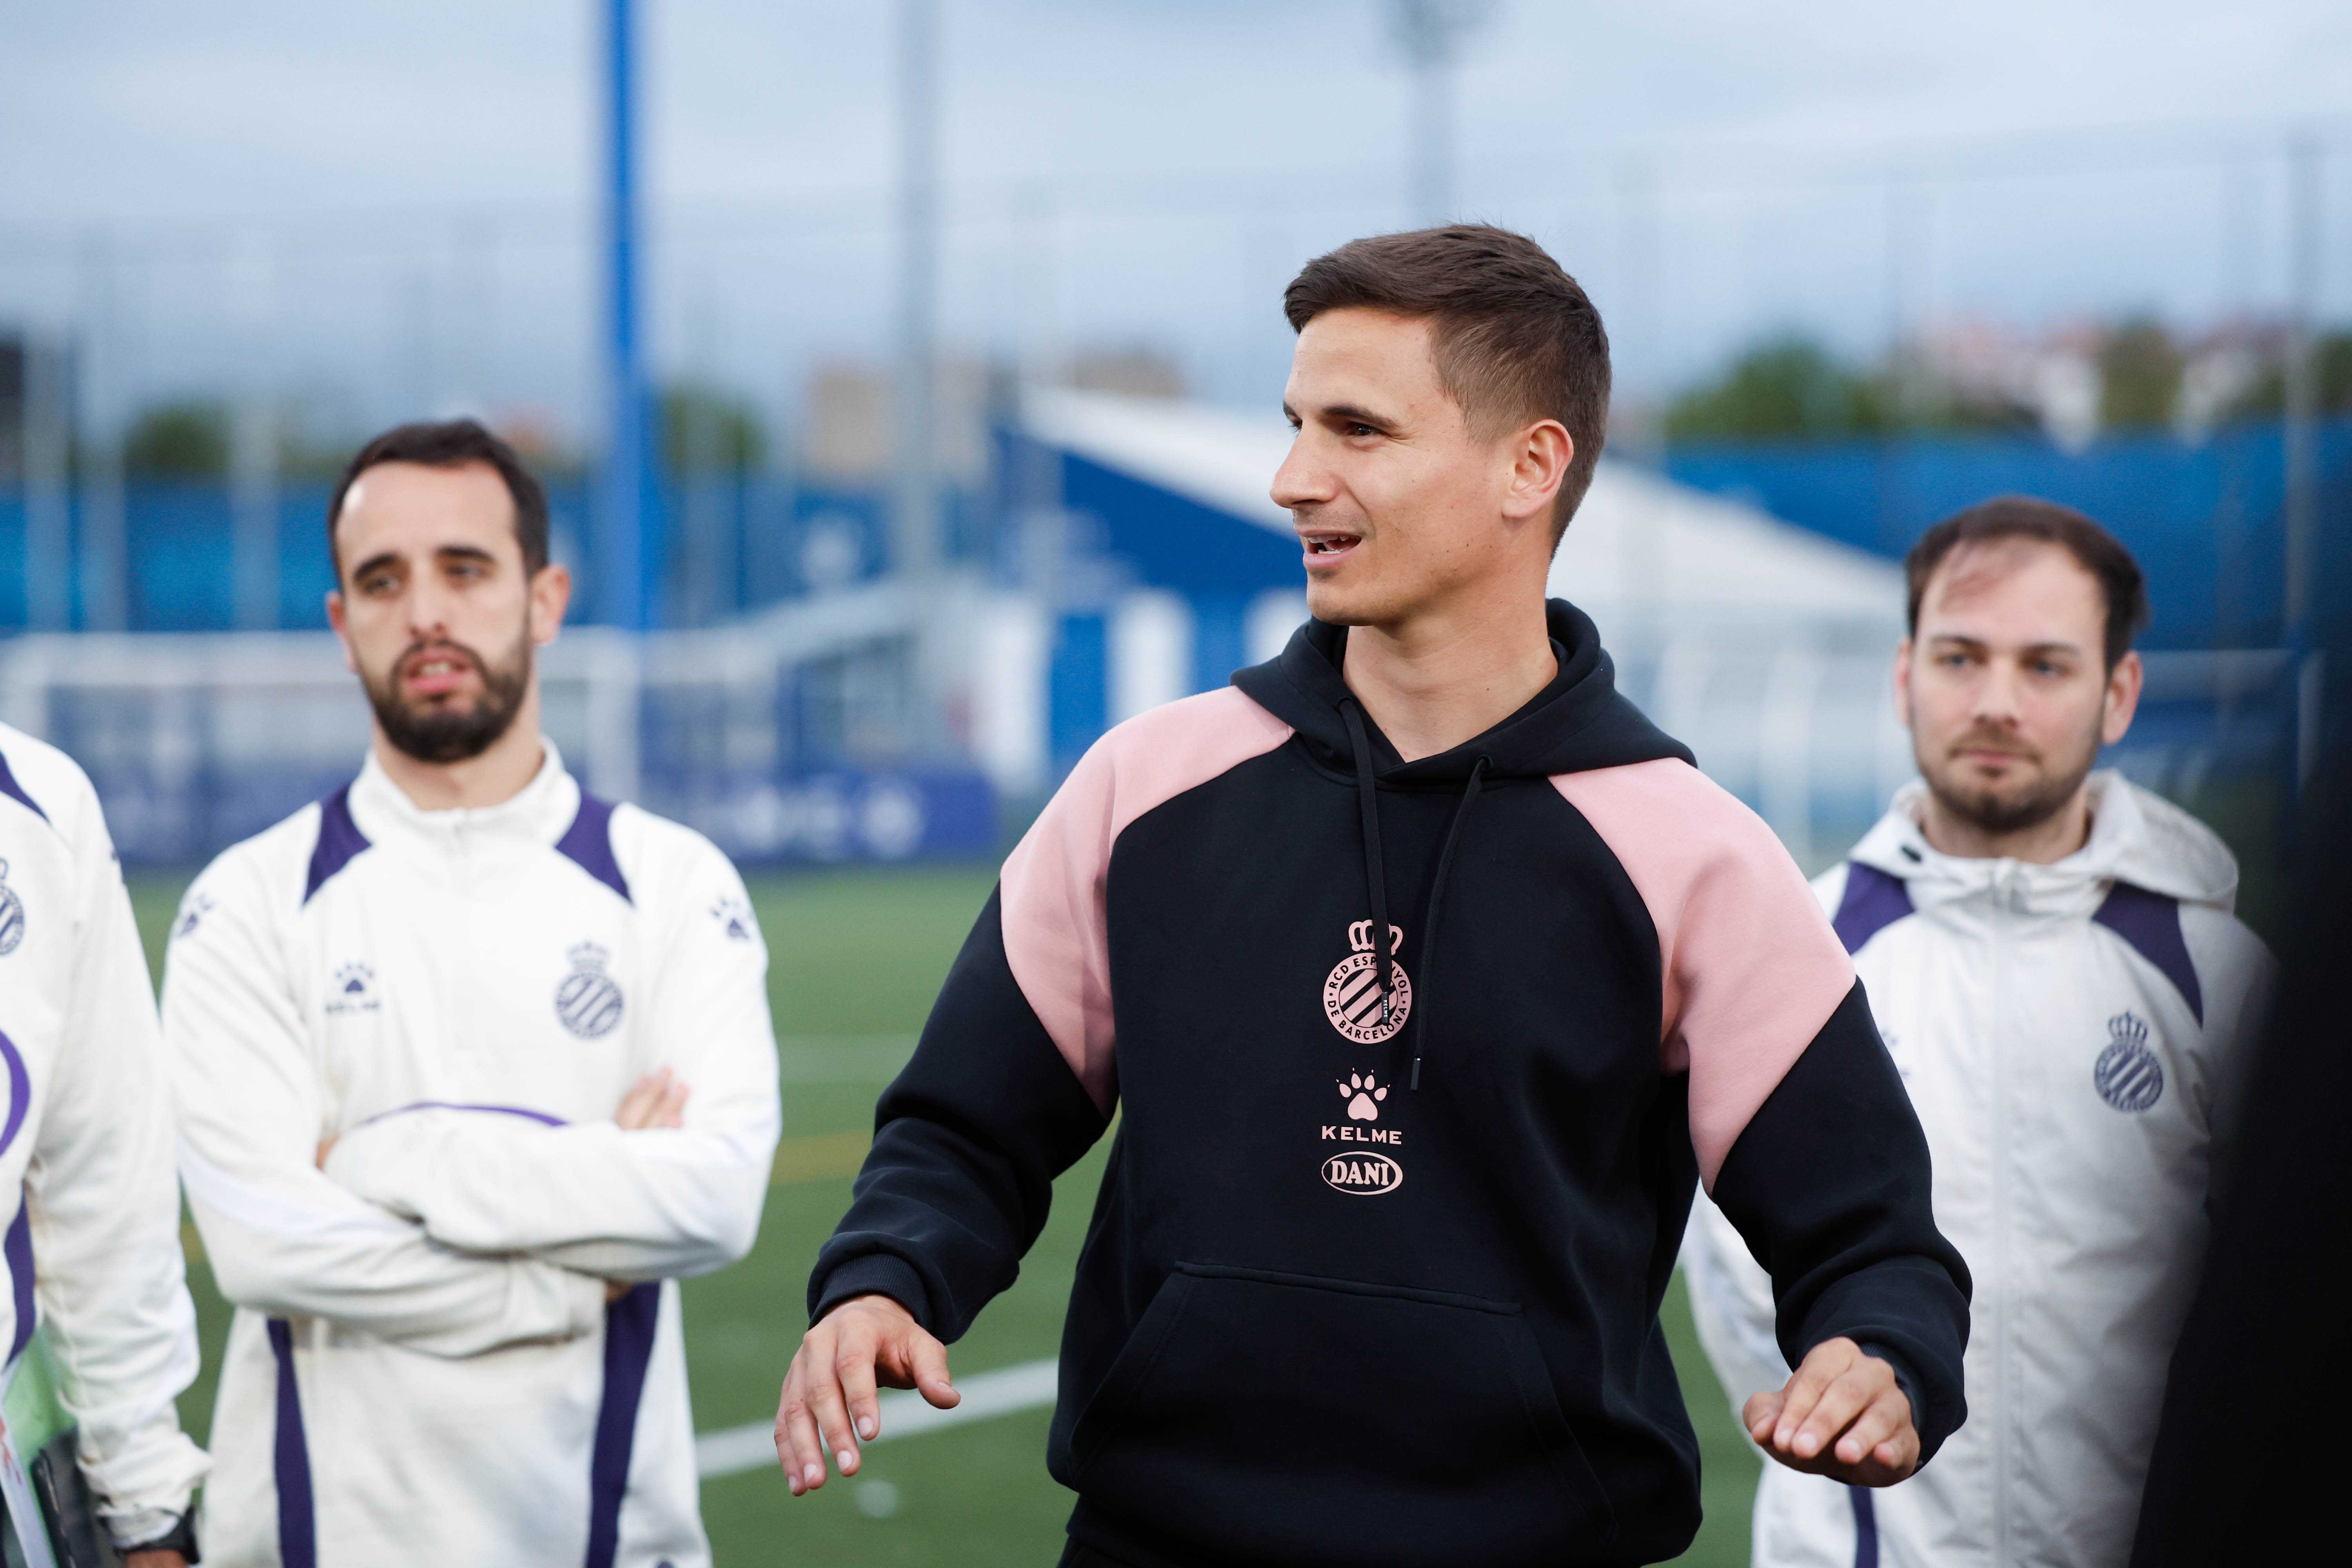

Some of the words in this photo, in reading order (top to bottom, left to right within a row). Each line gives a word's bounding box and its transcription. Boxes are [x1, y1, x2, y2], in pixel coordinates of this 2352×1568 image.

[1328, 965, 1349, 989] RCD
[1353, 956, 1408, 997] ESPYOL
[1327, 1000, 1340, 1017] DE
[1338, 1007, 1407, 1040] BARCELONA
[1321, 1125, 1402, 1145] KELME
[1330, 1160, 1389, 1186] DANI
